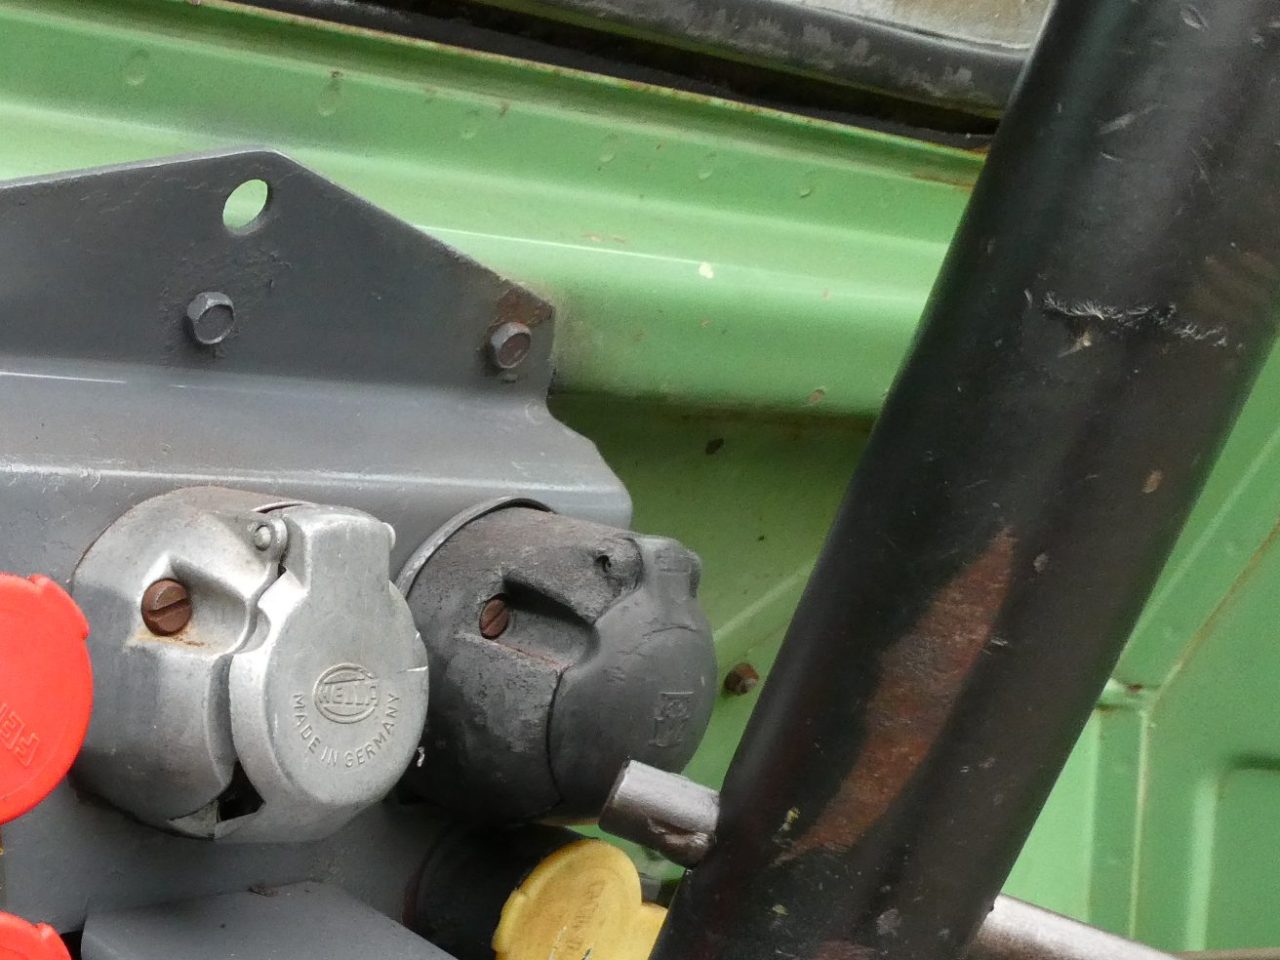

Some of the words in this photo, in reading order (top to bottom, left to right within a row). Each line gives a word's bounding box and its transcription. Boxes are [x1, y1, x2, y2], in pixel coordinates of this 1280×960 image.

[293, 693, 321, 754] MADE
[320, 745, 338, 768] IN
[344, 692, 401, 769] GERMANY
